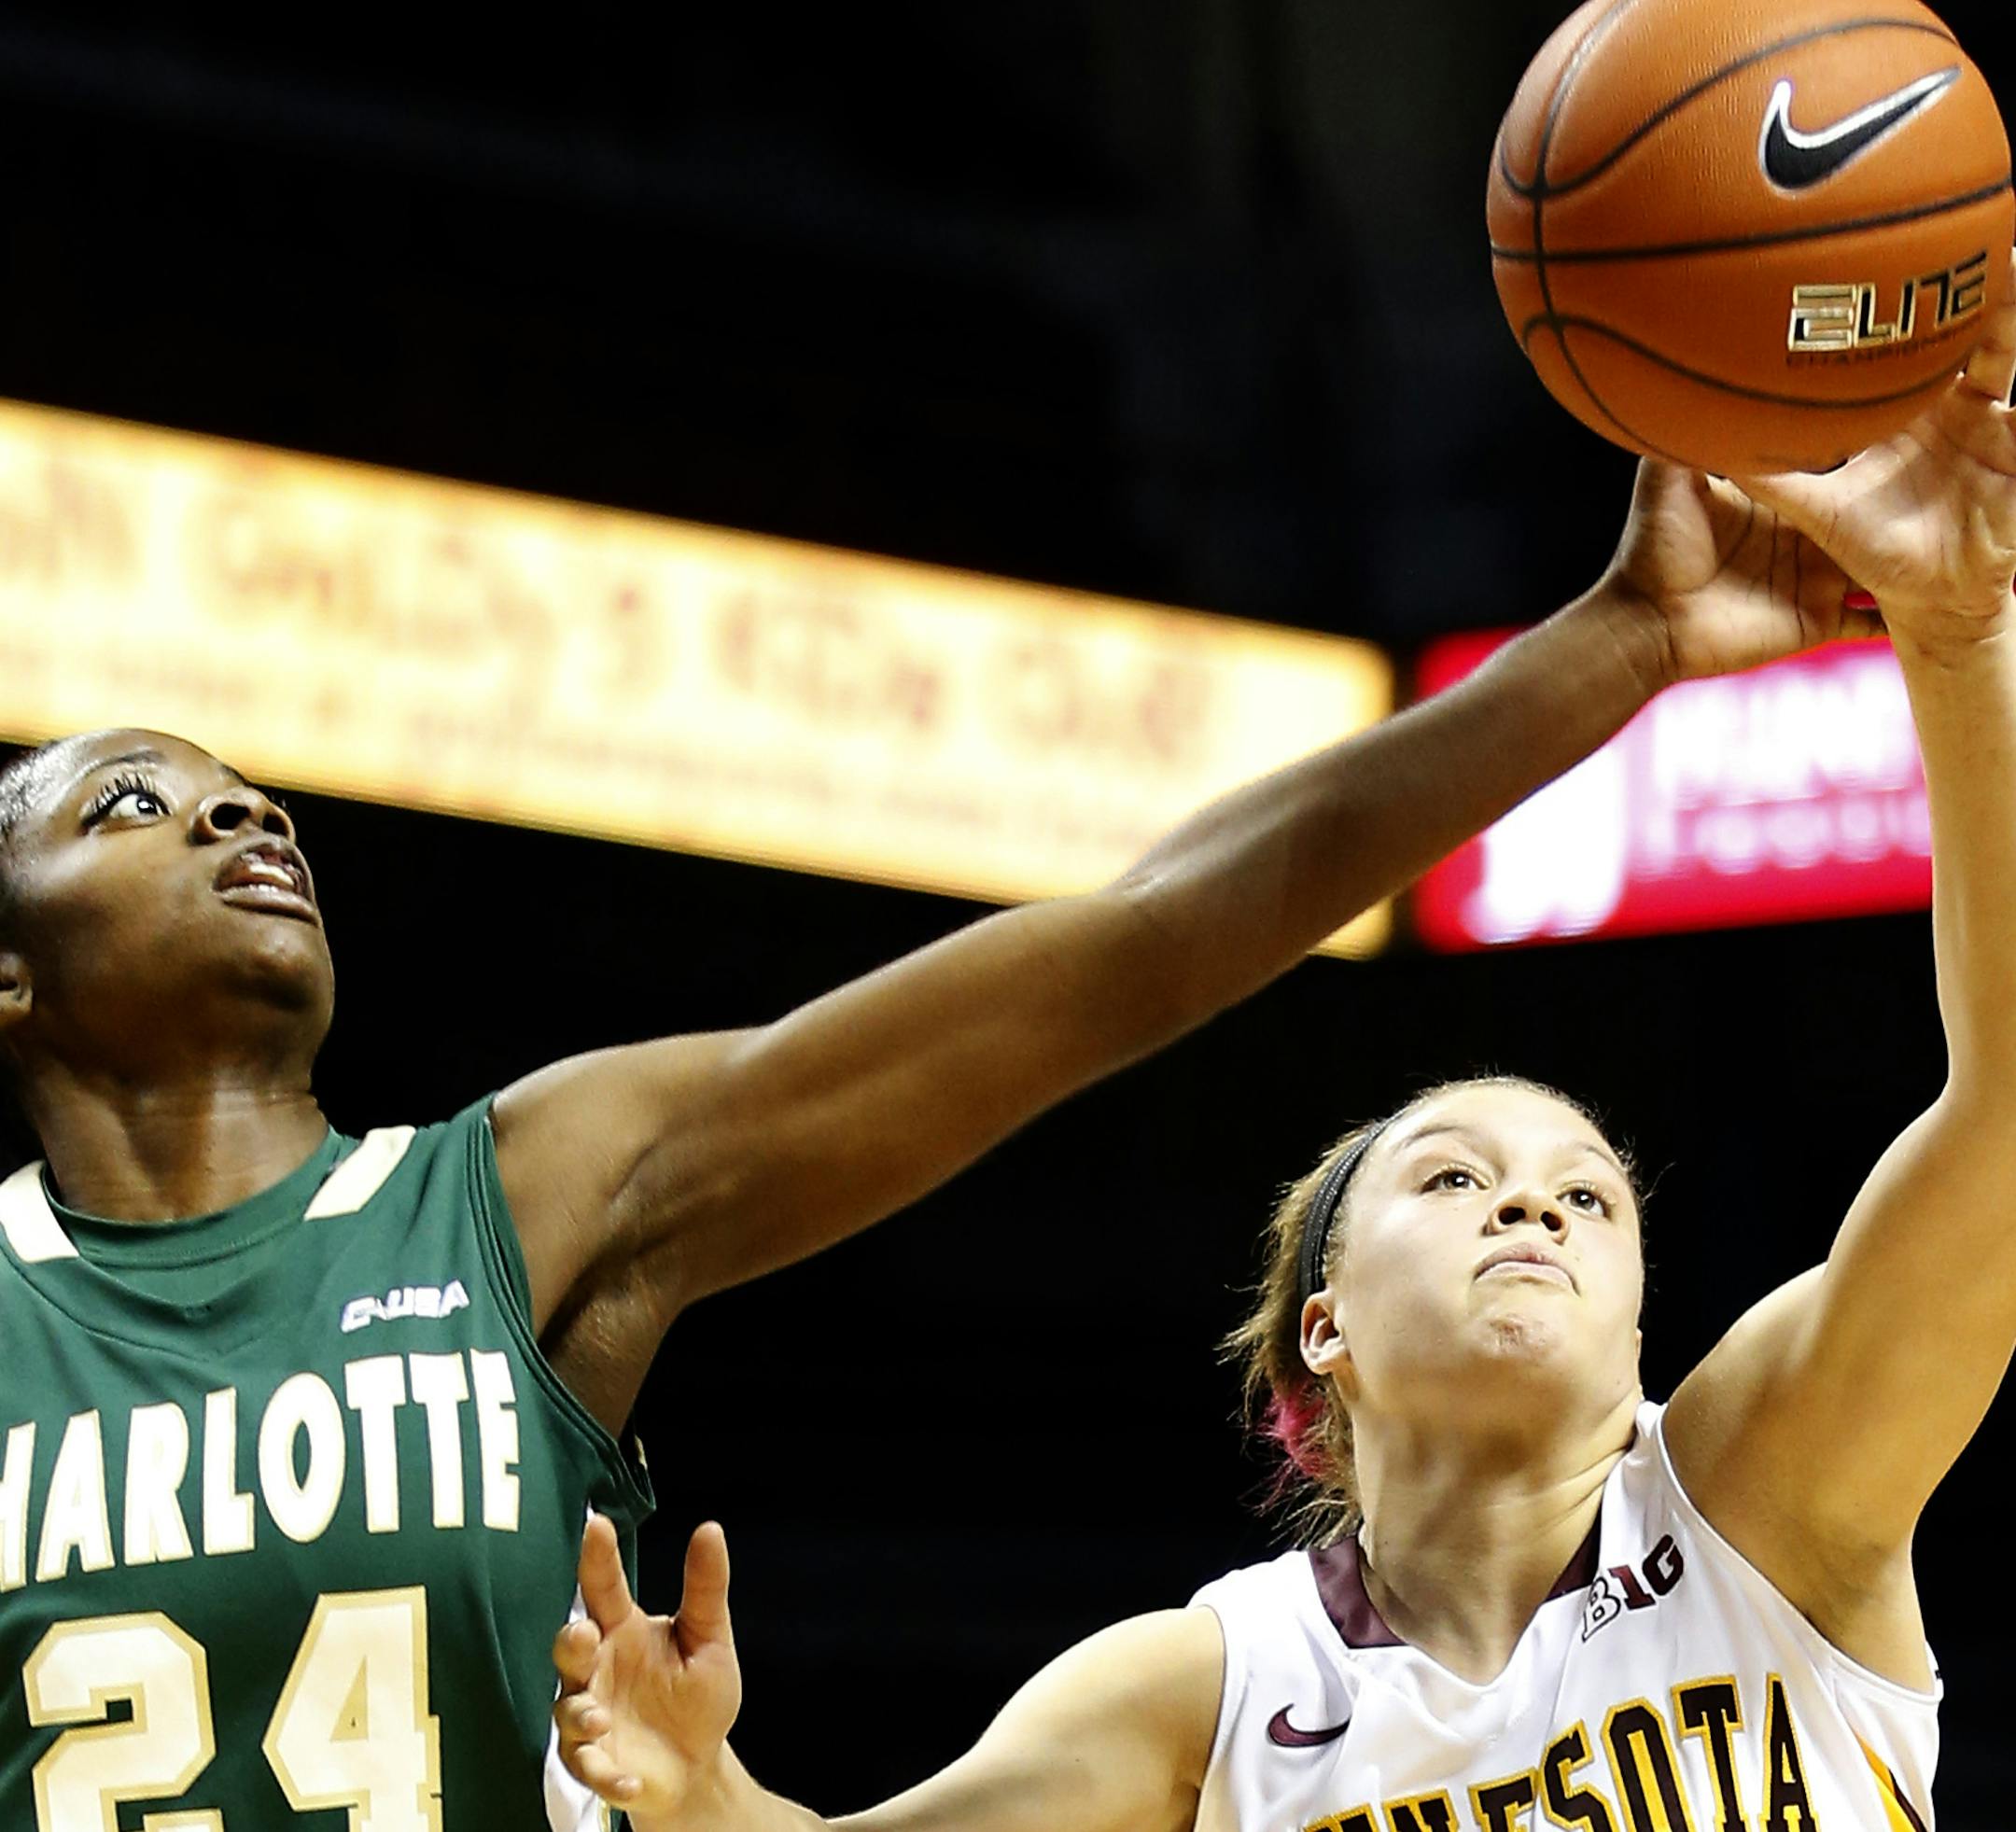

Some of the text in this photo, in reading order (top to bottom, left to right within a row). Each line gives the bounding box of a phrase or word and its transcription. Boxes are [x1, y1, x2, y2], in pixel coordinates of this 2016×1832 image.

[1787, 250, 1986, 351] ELITE
[22, 1586, 443, 1832] 24
[1299, 1672, 1821, 1832] SOTA
